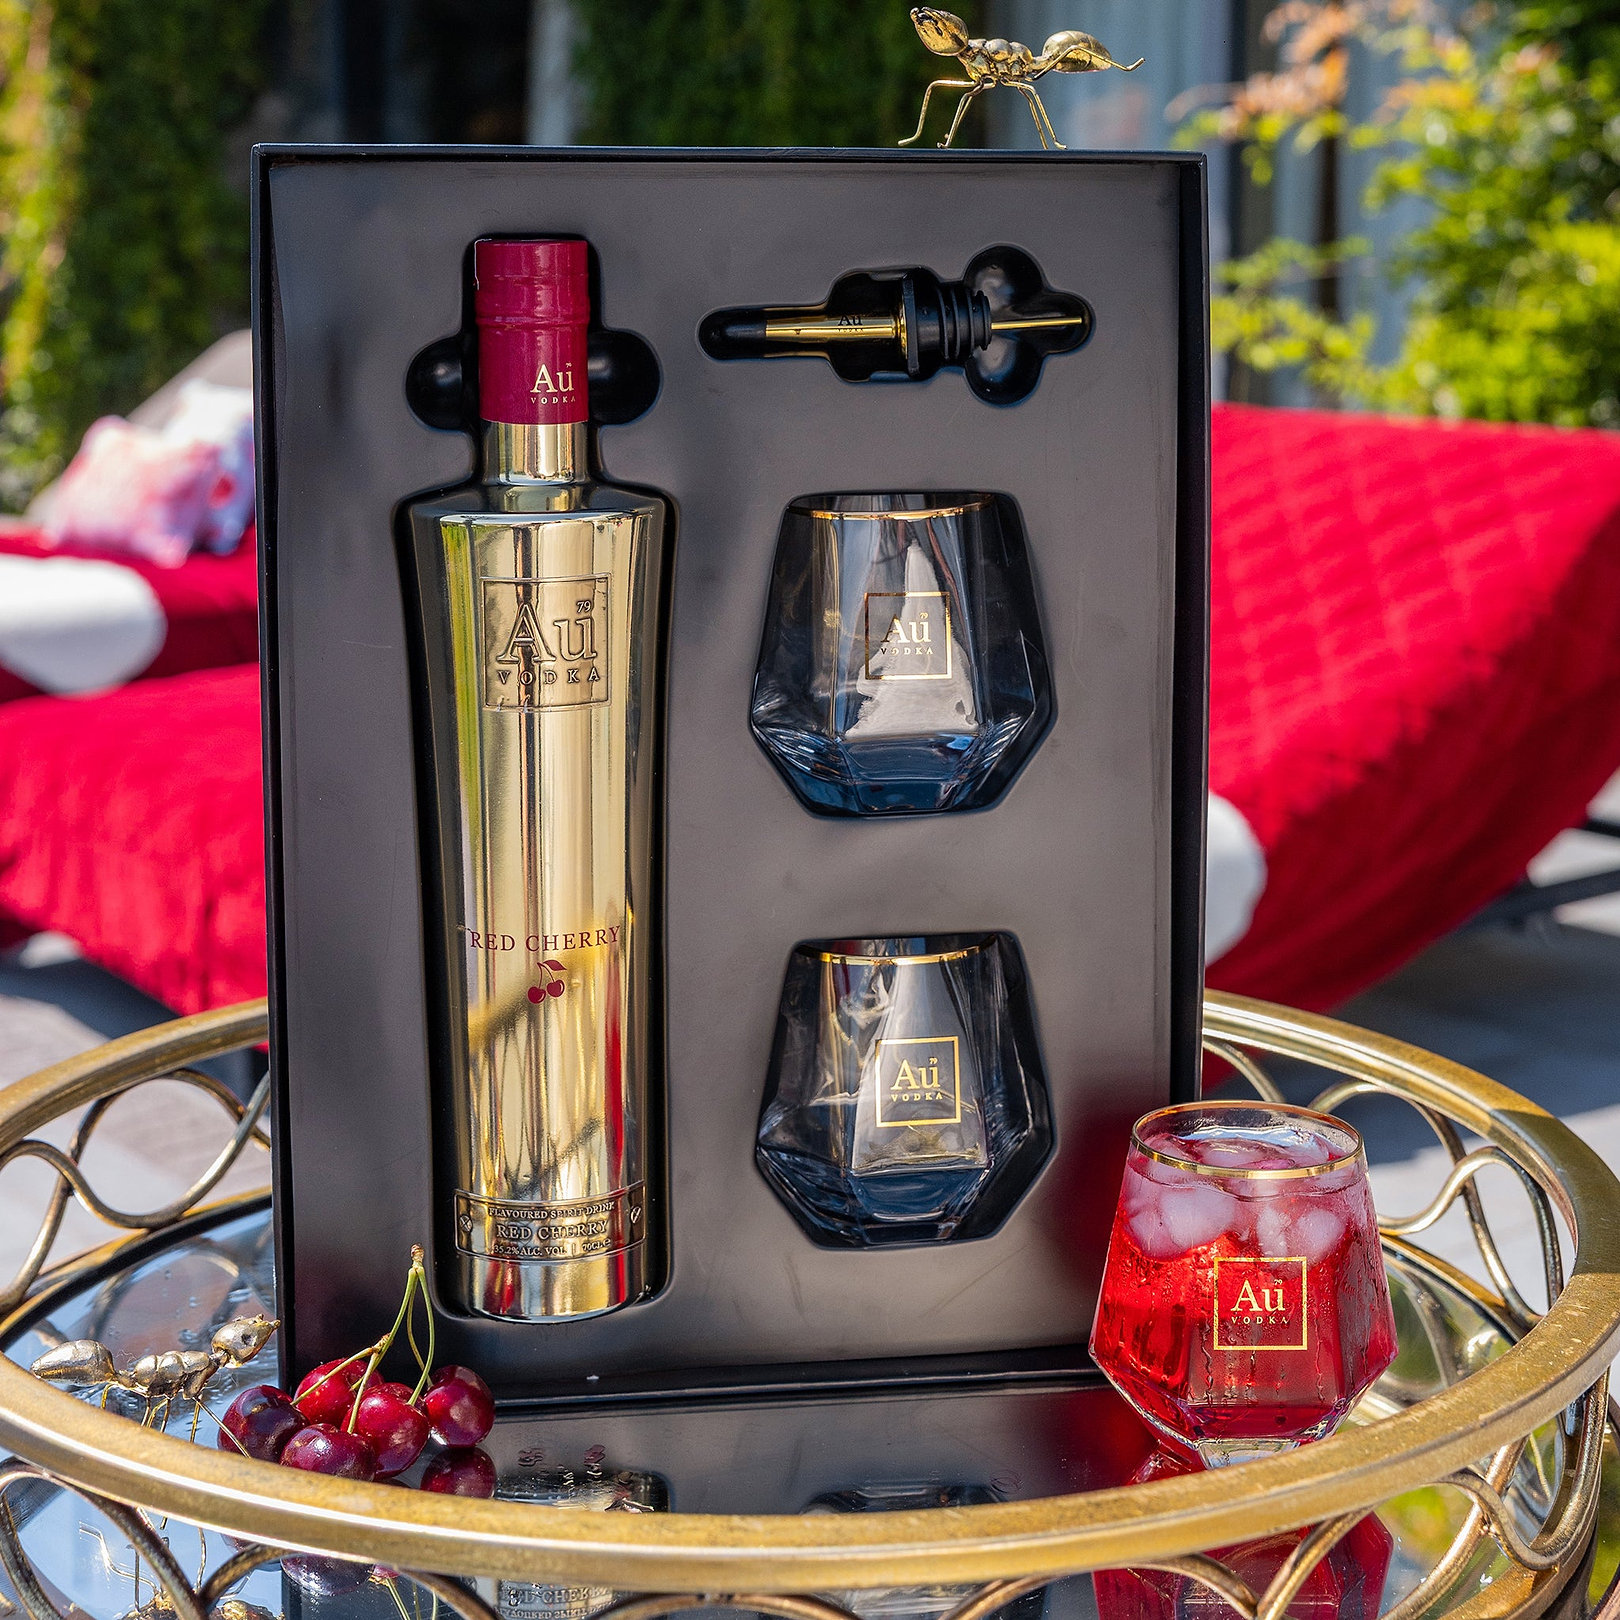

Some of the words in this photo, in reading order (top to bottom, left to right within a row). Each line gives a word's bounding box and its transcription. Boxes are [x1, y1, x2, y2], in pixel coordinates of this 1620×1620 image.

[530, 363, 574, 393] Au
[530, 396, 576, 404] VODKA
[496, 602, 598, 663] Au
[576, 600, 592, 613] 79
[880, 613, 931, 643] Au
[880, 647, 933, 655] VODKA
[497, 667, 600, 685] VODKA
[470, 931, 516, 951] RED
[525, 925, 620, 951] CHERRY
[890, 1059, 941, 1090] Au
[890, 1092, 943, 1102] VODKA
[489, 1207, 548, 1219] FLAVOURED
[550, 1208, 584, 1218] SPIRIT
[585, 1201, 615, 1215] DRINK
[496, 1224, 532, 1240] RED
[538, 1219, 608, 1240] CHERRY
[1230, 1279, 1286, 1311] Au
[1231, 1316, 1289, 1324] VODKA
